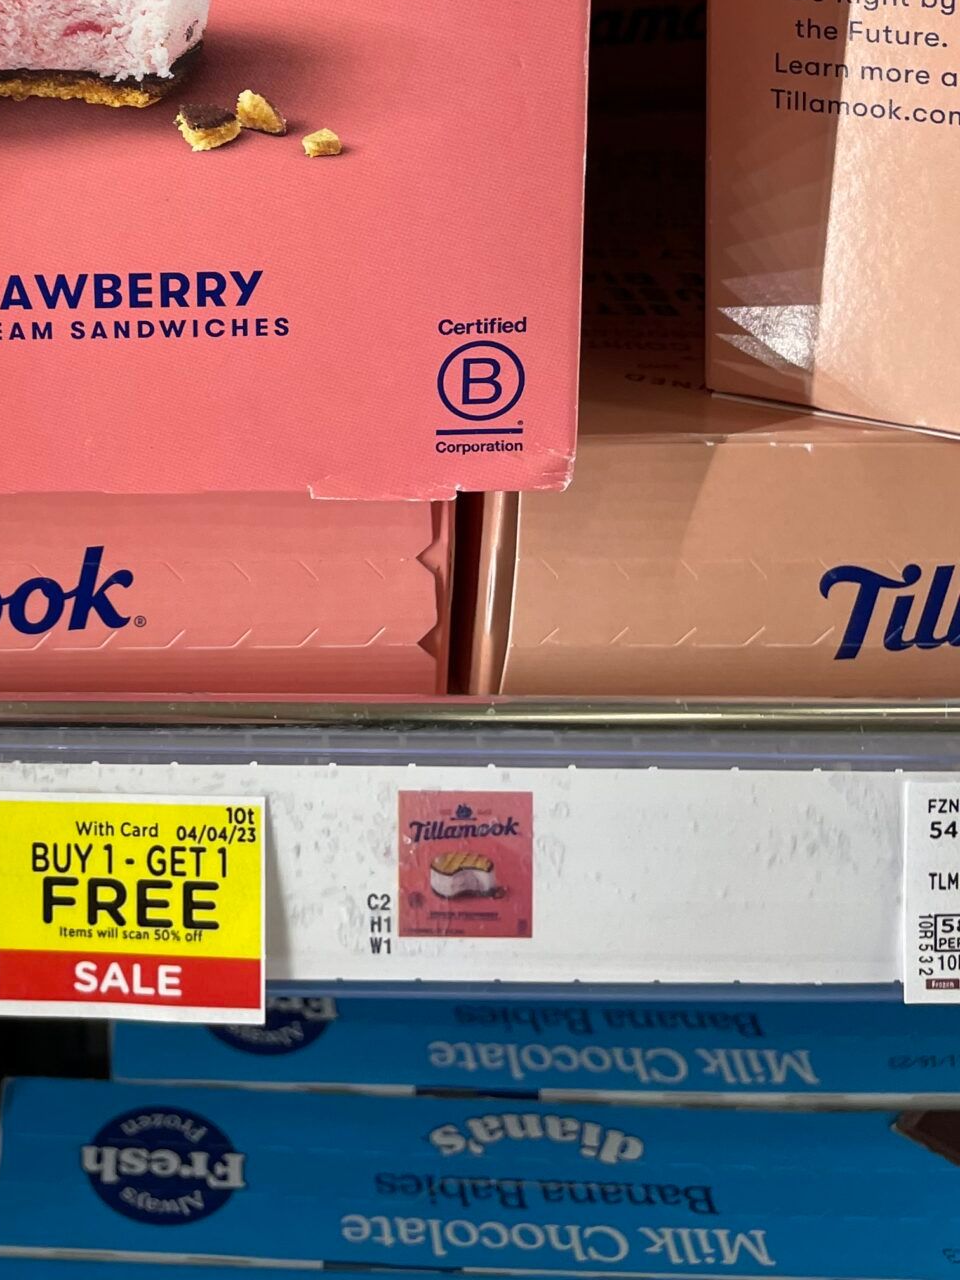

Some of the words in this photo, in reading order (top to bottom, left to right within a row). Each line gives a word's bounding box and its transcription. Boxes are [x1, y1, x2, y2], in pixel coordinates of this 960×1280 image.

[795, 18, 838, 40] the
[848, 20, 948, 48] Future.
[775, 52, 849, 78] Learn
[860, 65, 930, 85] more
[70, 317, 291, 341] SANDWICHES
[437, 316, 528, 337] Certified
[435, 438, 524, 455] Corporation
[75, 820, 115, 838] With
[120, 822, 159, 838] Card
[226, 806, 255, 826] 10t
[928, 799, 959, 814] FZN
[176, 825, 257, 844] 04/04/23
[409, 817, 520, 843] Tillamook
[929, 821, 958, 839] 54
[32, 841, 94, 874] BUY
[146, 845, 207, 877] GET
[42, 876, 220, 930] FREE
[367, 893, 391, 911] C2
[59, 927, 93, 938] Items
[97, 927, 118, 939] will
[122, 931, 150, 940] scan
[154, 930, 180, 942] 50%
[185, 930, 203, 942] off
[370, 916, 392, 933] H1
[370, 937, 392, 954] W1
[73, 961, 183, 997] SALE
[453, 1006, 595, 1039] Babies
[604, 1009, 766, 1040] Banana
[427, 1040, 689, 1084] Chocolate
[696, 1046, 821, 1086] Milk
[120, 1112, 209, 1144] Frozen
[429, 1112, 645, 1166] diana's
[80, 1145, 247, 1191] Fresh
[120, 1185, 206, 1219] Always
[375, 1172, 528, 1214] Babies
[537, 1180, 721, 1217] Banana
[341, 1212, 630, 1265] Chocolate
[636, 1225, 778, 1267] Milk
